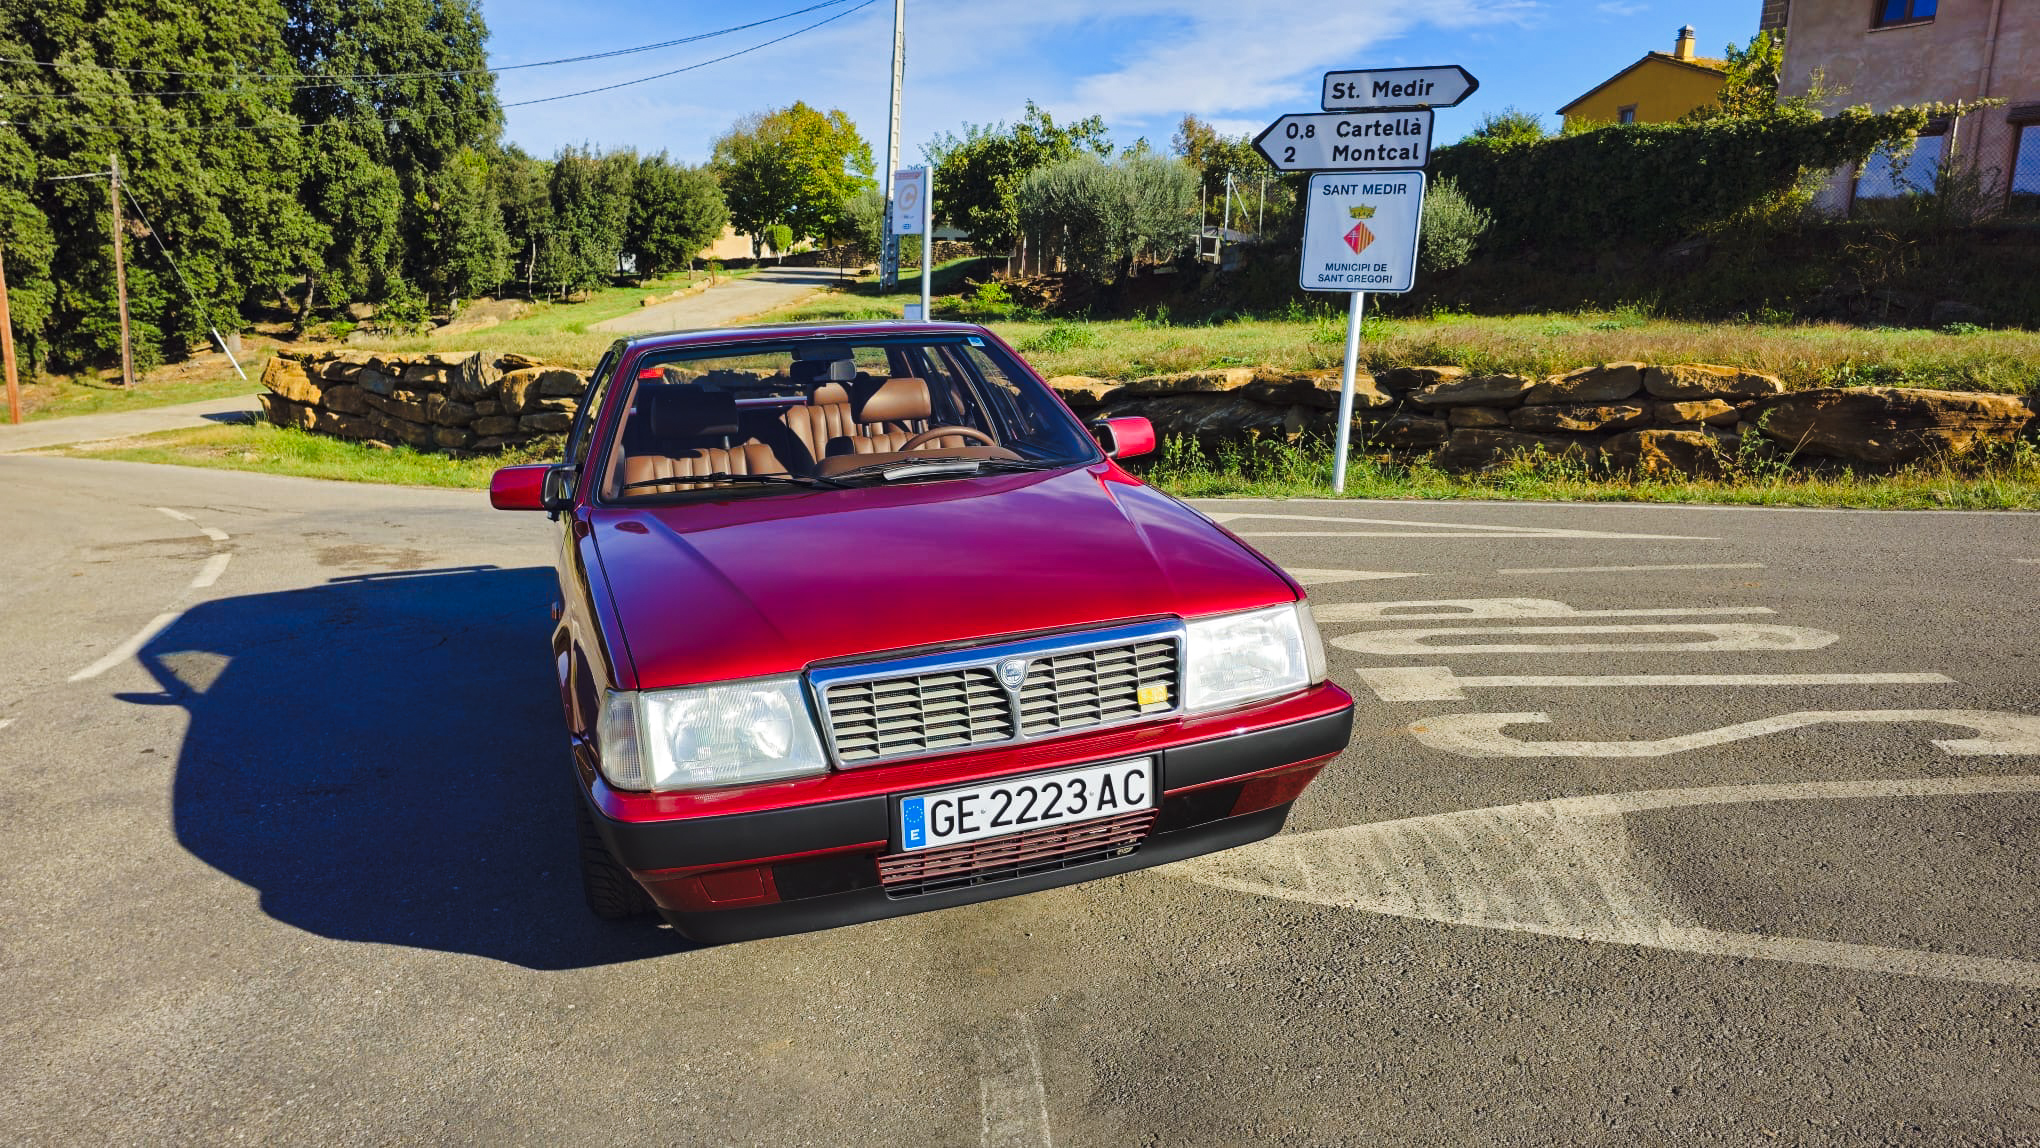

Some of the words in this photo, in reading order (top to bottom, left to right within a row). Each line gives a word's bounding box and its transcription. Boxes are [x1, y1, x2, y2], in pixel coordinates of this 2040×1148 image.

[1331, 82, 1360, 99] St.
[1371, 78, 1434, 98] Medir
[1336, 117, 1422, 138] Cartellà
[1284, 146, 1296, 163] 2
[1332, 143, 1419, 162] Montcal
[1322, 184, 1358, 196] SANT
[1362, 183, 1407, 195] MEDIR
[1325, 263, 1370, 272] MUNICIPI
[1373, 263, 1388, 272] DE
[1317, 273, 1344, 283] SANT
[1346, 274, 1393, 283] GREGORI
[930, 794, 980, 837] GE
[989, 778, 1088, 829] 2223
[1096, 769, 1145, 811] AC
[910, 829, 920, 841] E
